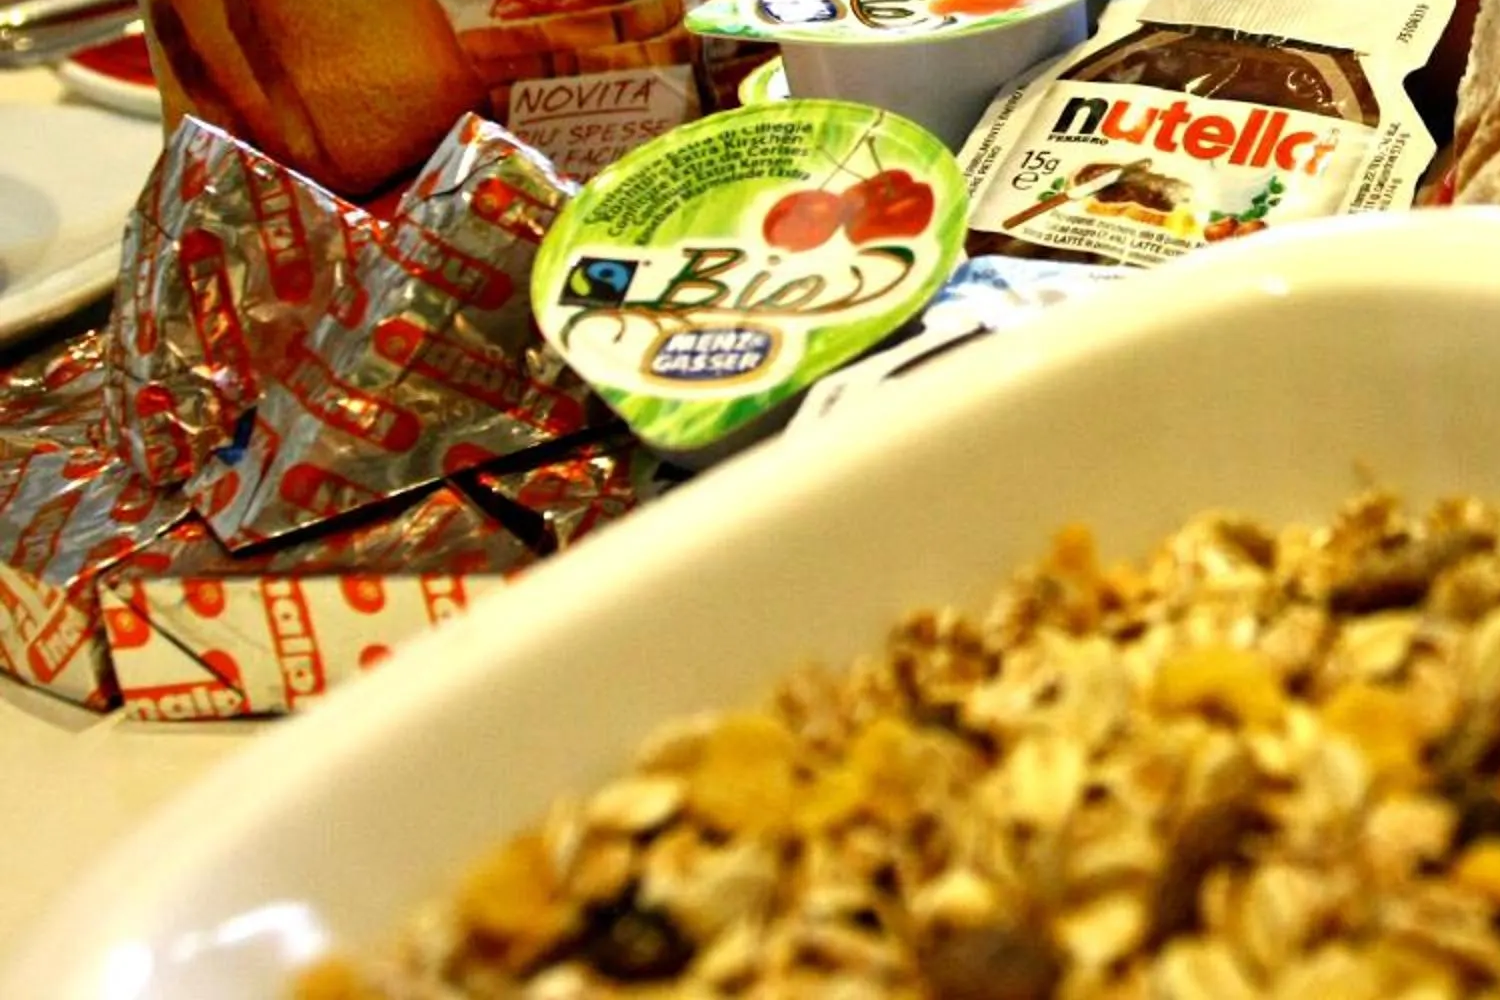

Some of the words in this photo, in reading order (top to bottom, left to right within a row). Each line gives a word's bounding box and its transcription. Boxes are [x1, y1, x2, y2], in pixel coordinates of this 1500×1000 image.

[1047, 133, 1109, 146] FERRERO
[1051, 97, 1337, 176] nutella
[1020, 150, 1061, 175] 15g
[655, 247, 827, 312] Bio
[652, 351, 762, 373] GASSER
